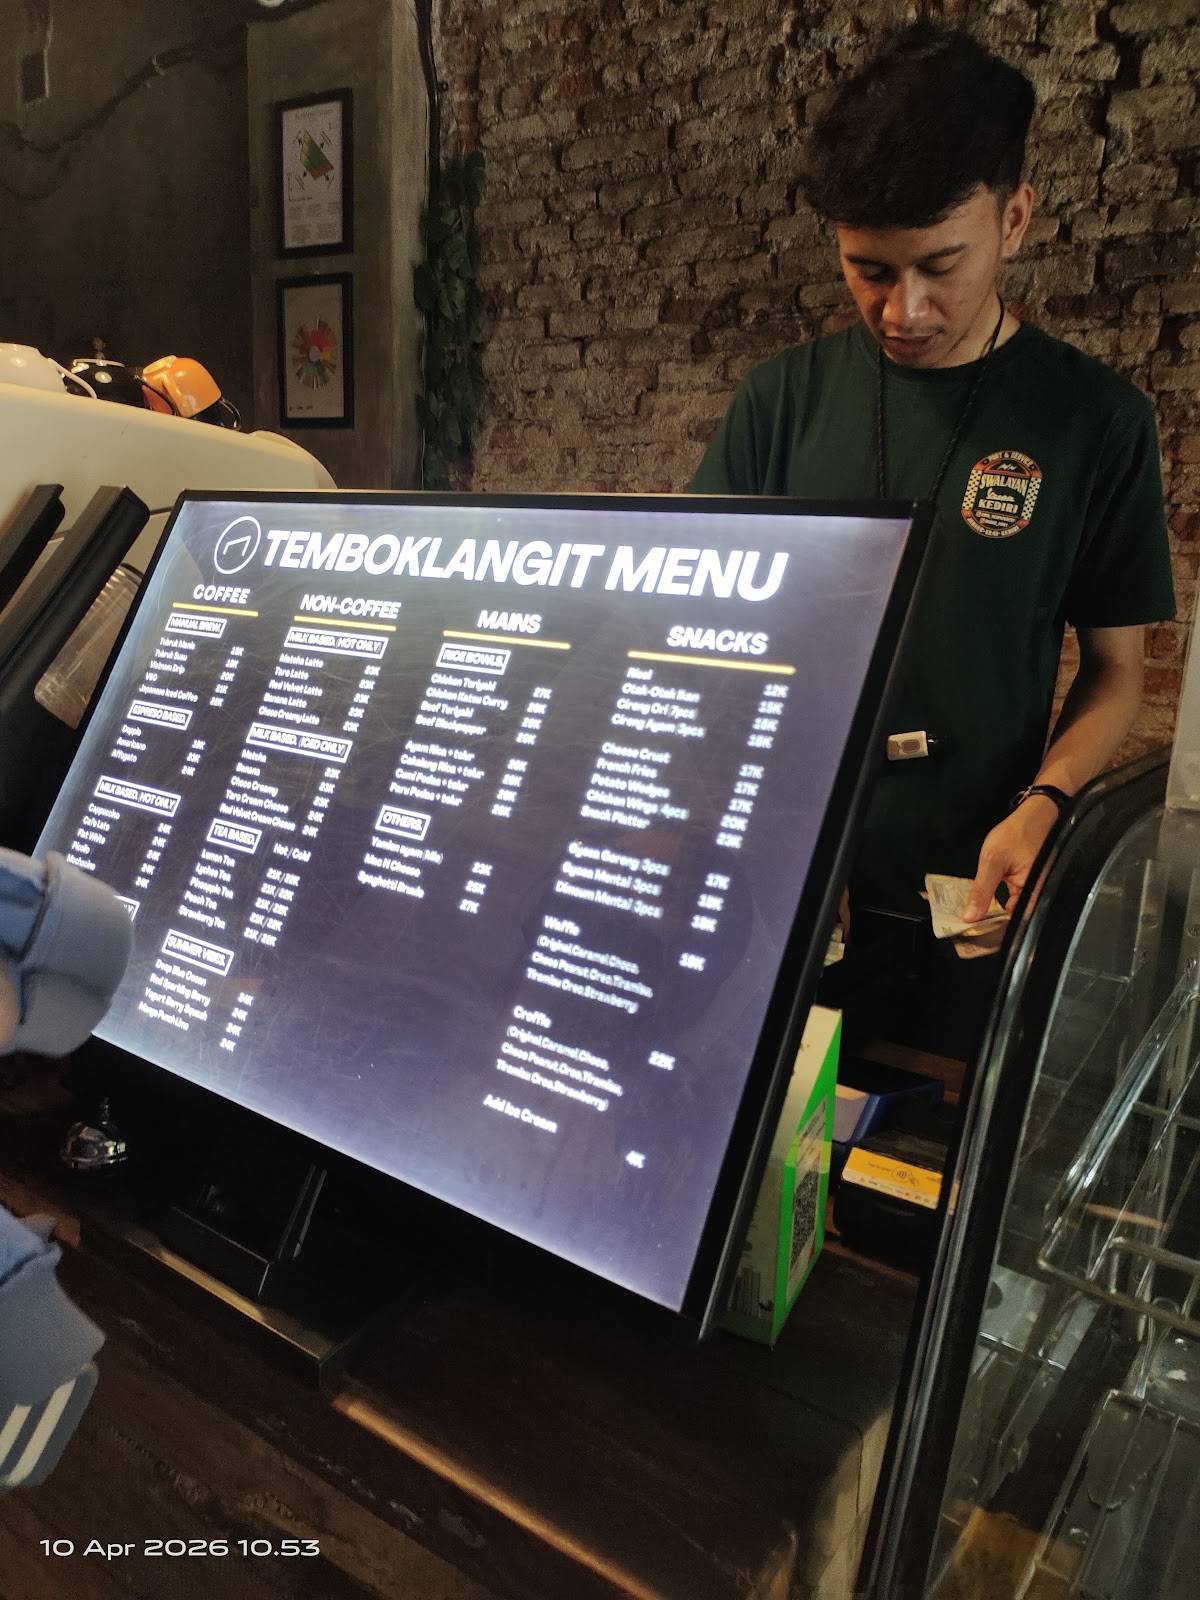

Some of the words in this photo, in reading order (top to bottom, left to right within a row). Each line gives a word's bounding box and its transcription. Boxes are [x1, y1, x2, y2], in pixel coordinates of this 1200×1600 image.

[979, 473, 1030, 497] SWALAYAN
[978, 499, 1019, 514] KEDIRI
[263, 530, 604, 587] TEMBOKLANGIT
[604, 545, 789, 601] MENU
[192, 583, 250, 604] COFFEE
[299, 593, 401, 619] NON-COFFEE
[170, 617, 198, 629] MANUAL
[476, 609, 542, 633] MAINS
[666, 624, 768, 655] SNACKS
